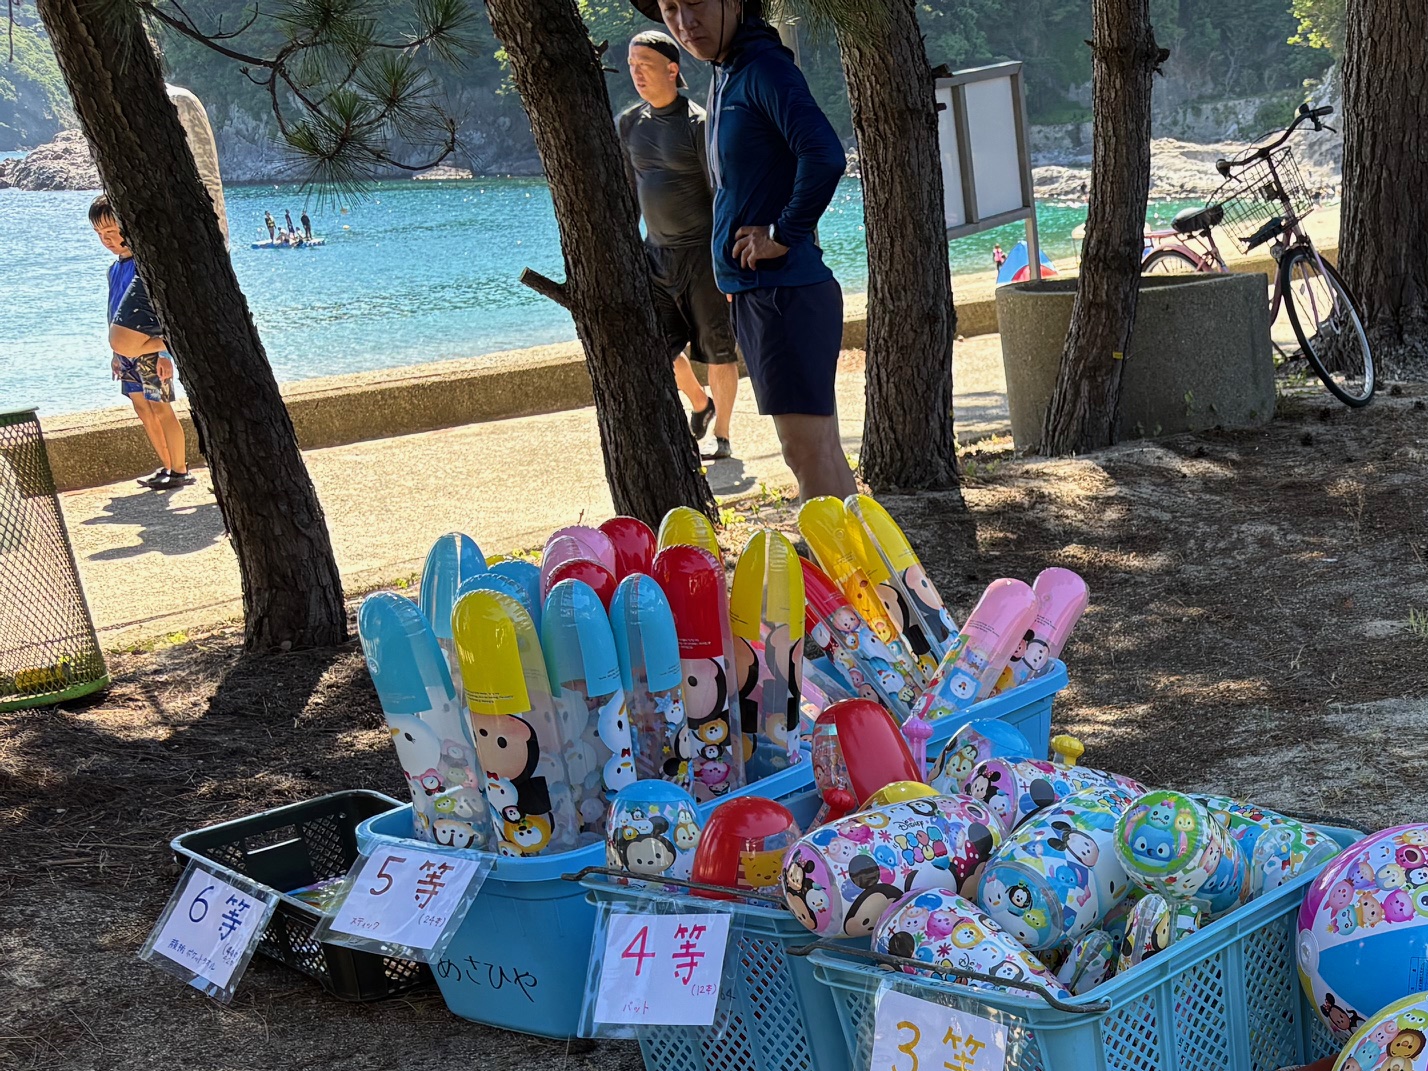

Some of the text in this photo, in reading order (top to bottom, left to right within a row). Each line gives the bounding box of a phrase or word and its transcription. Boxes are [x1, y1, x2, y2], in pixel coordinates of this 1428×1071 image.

[893, 819, 924, 831] Disney
[622, 1001, 649, 1015] バット
